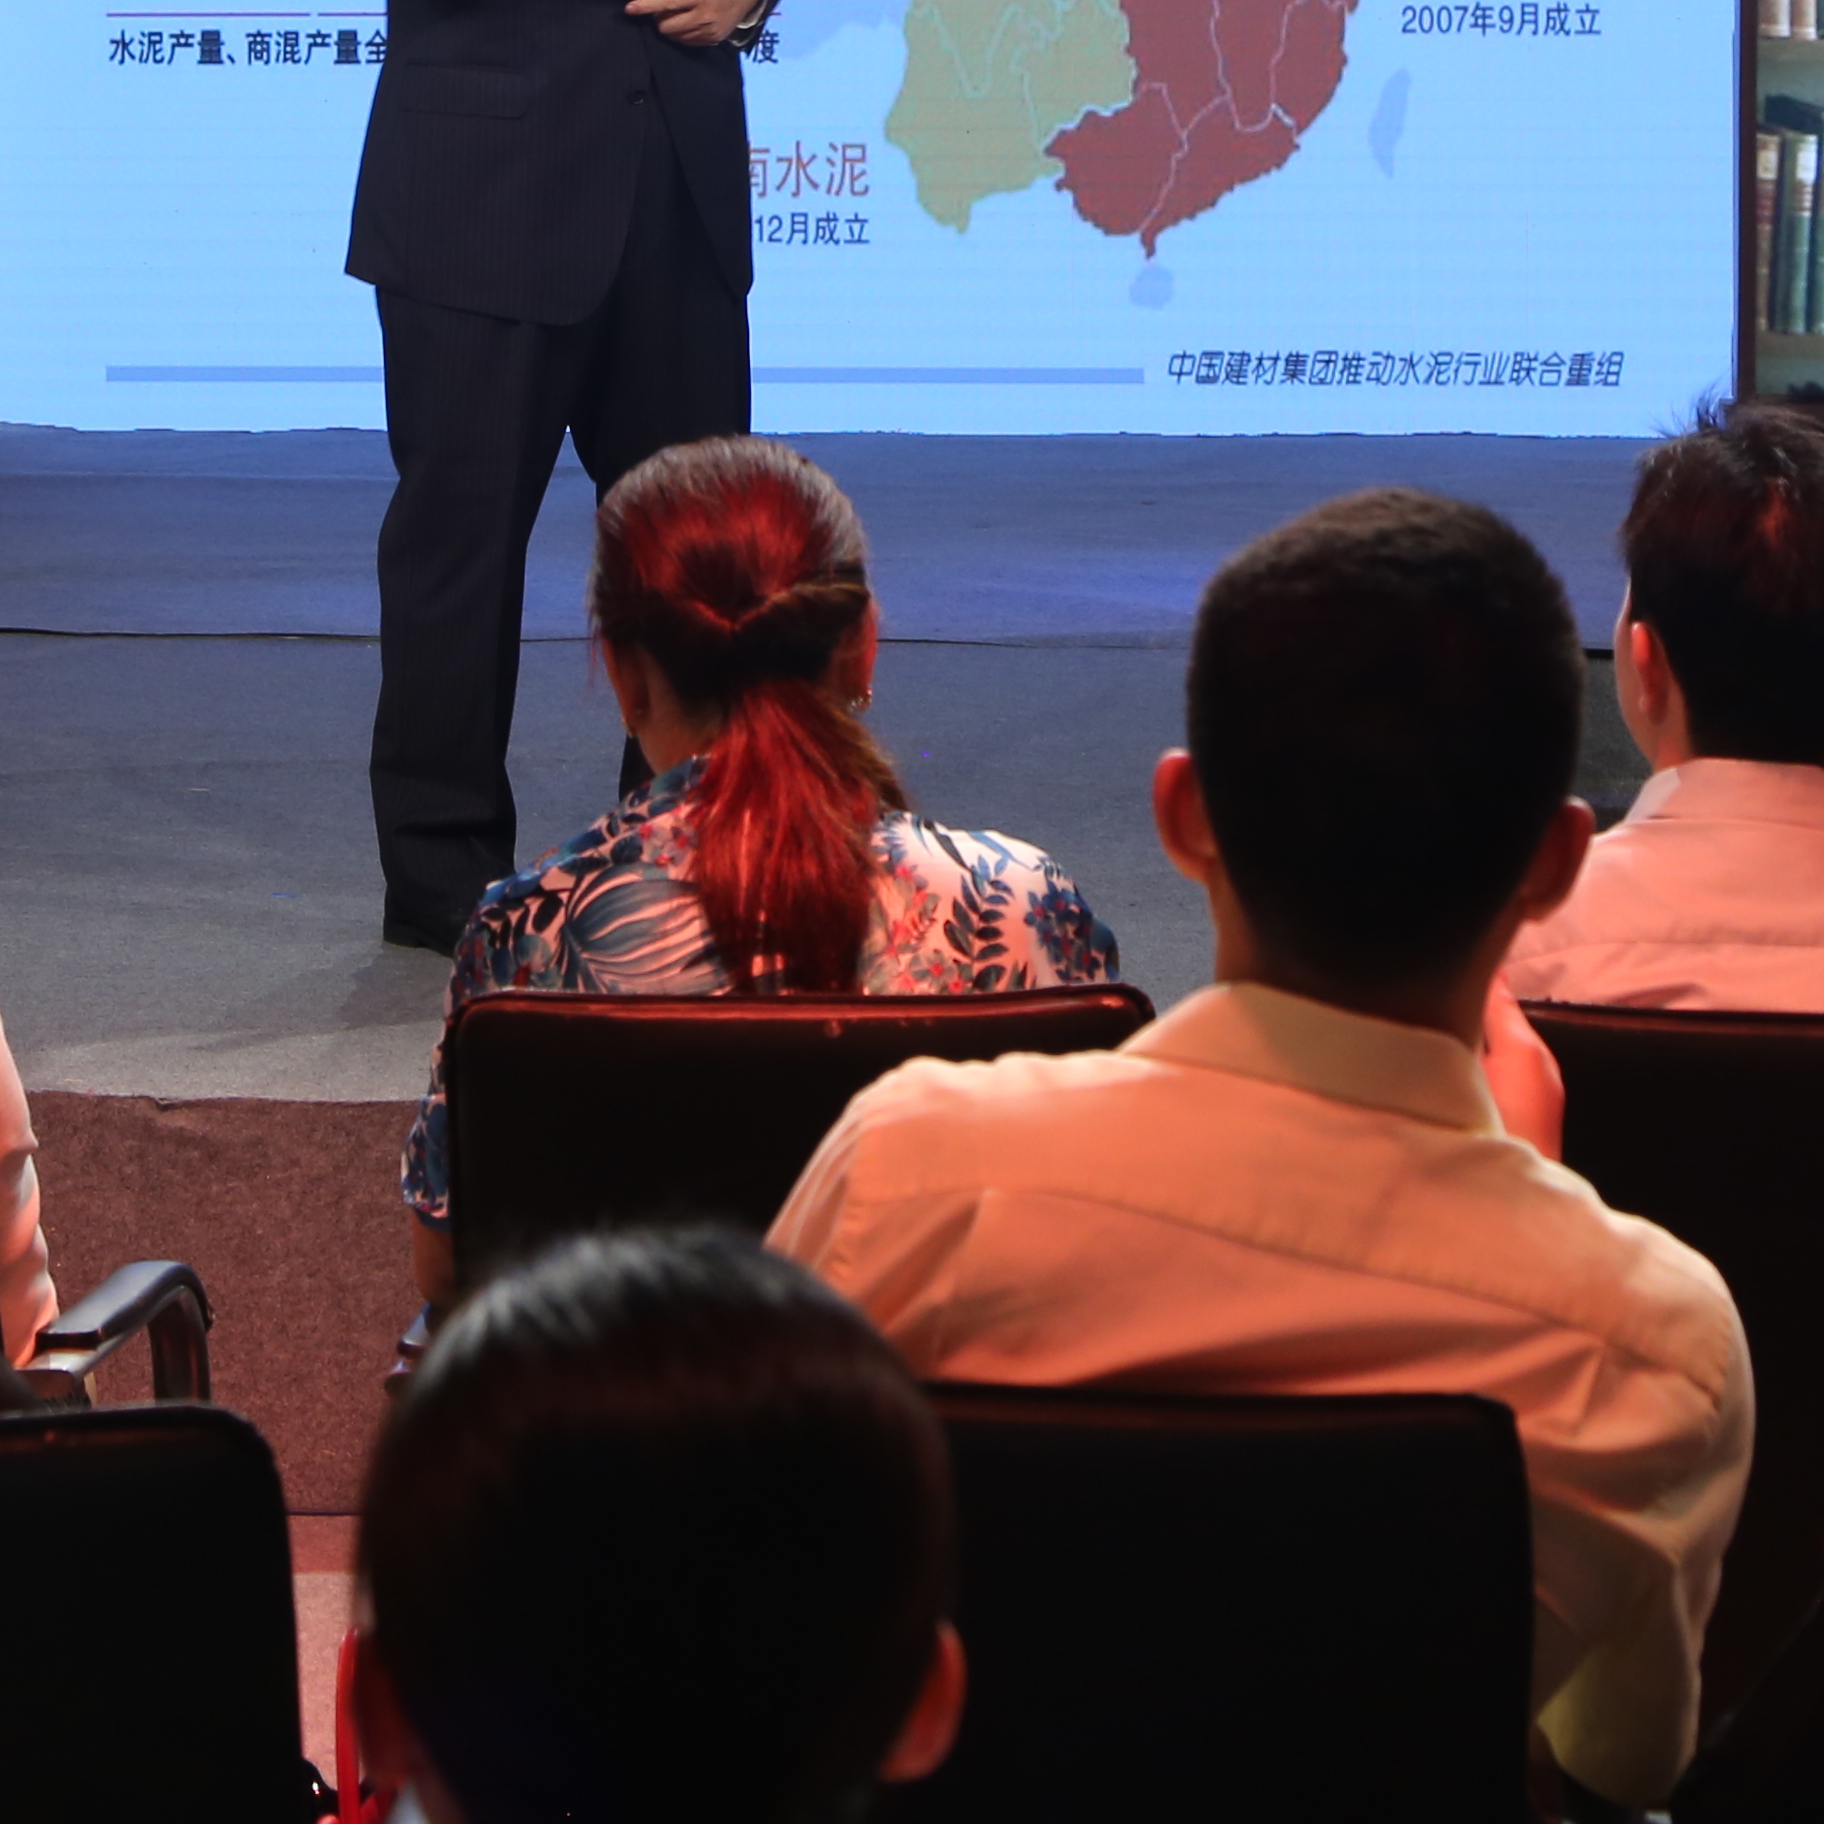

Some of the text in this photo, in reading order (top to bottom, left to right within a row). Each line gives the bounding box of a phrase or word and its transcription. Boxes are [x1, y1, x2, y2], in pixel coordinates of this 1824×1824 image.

[1401, 2, 1602, 37] 2007年9月成立
[754, 211, 870, 246] 12月成立
[1166, 350, 1625, 388] 中国建材集团推动水泥行业联合重组
